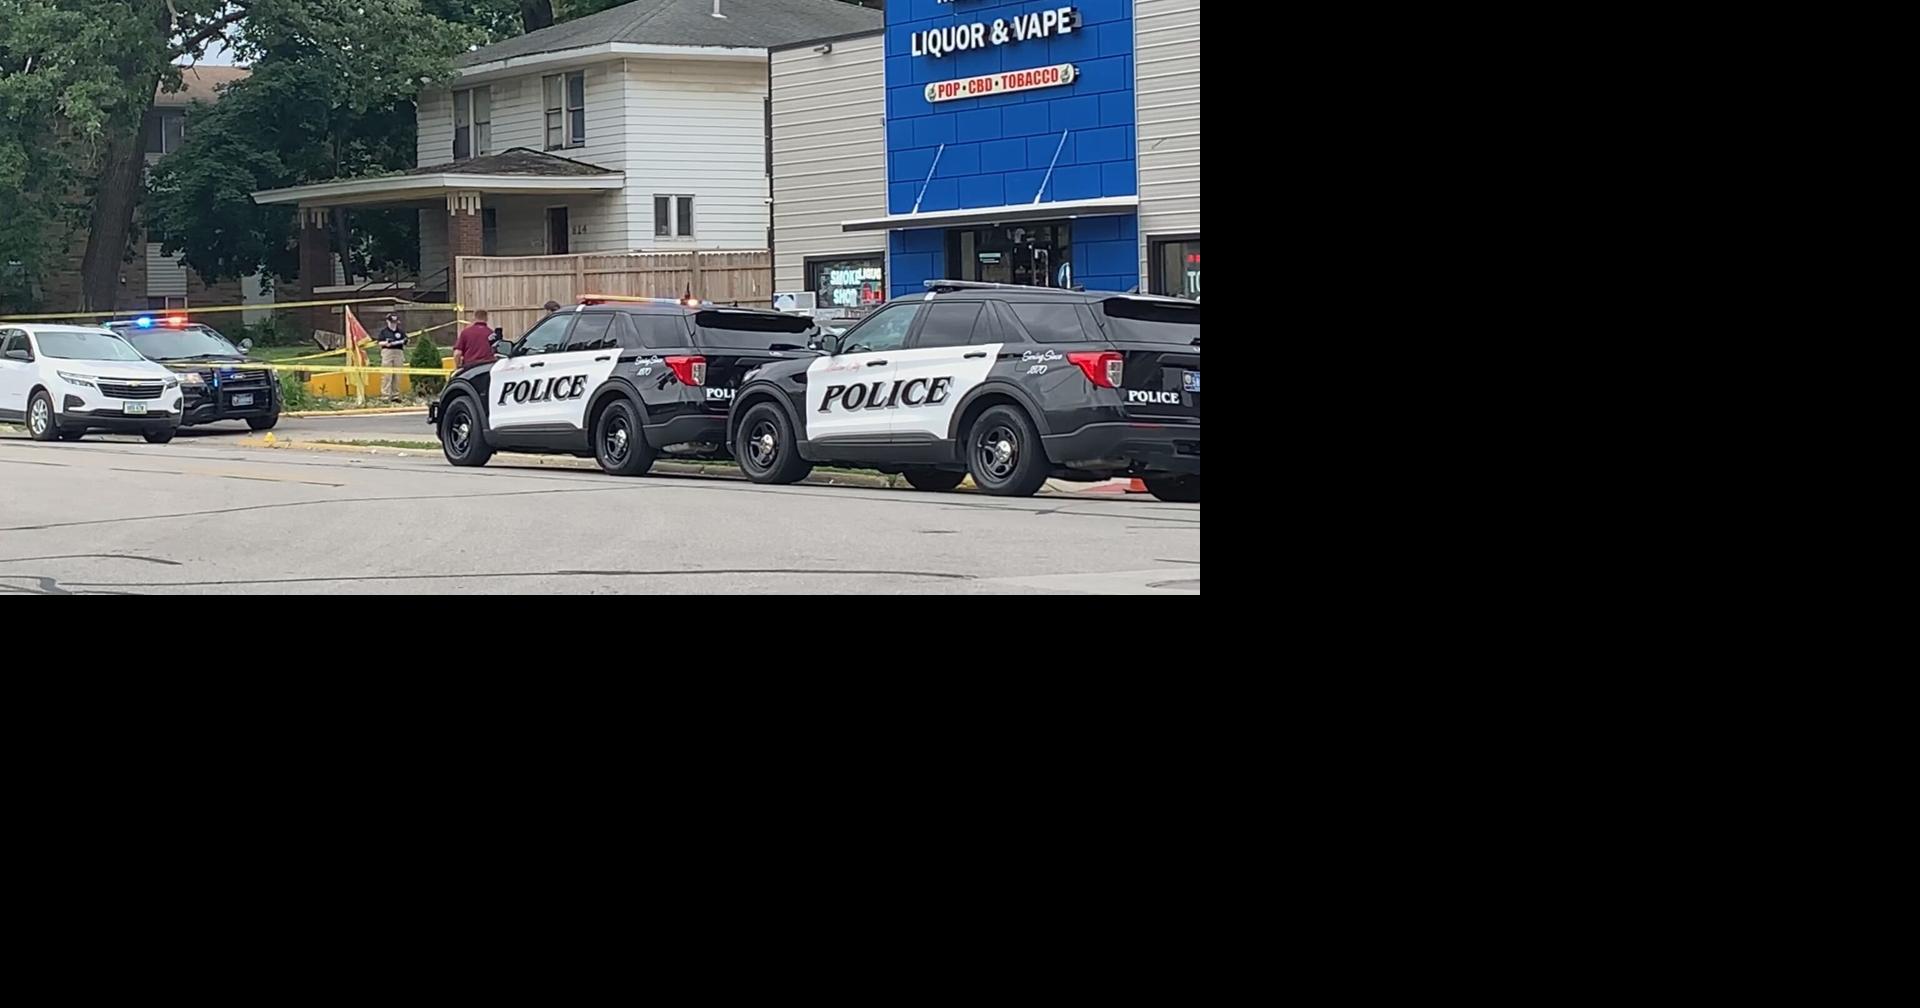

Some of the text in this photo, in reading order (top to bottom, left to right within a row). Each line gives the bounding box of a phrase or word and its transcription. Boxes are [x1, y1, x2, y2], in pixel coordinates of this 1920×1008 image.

[911, 7, 1073, 58] LIQUOR & VAPE
[937, 68, 1059, 99] POP CBD TOBACCO
[497, 375, 588, 406] POLICE
[817, 376, 955, 413] POLICE
[1128, 390, 1180, 405] POLICE
